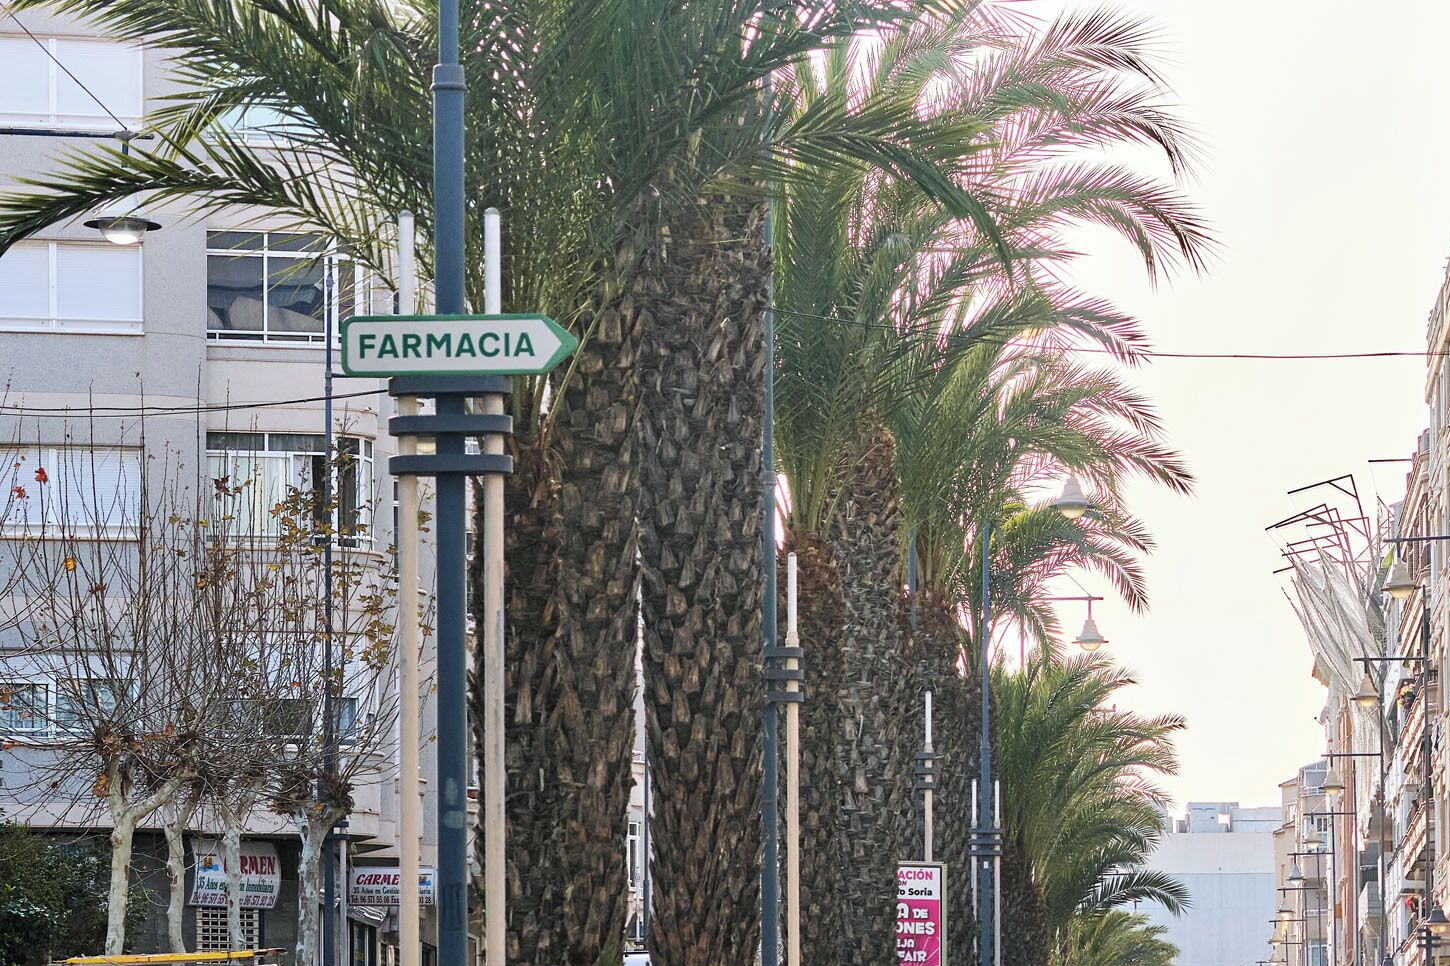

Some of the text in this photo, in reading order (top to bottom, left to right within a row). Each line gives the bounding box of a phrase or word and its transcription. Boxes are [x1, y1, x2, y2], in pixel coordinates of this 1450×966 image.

[359, 332, 535, 359] FARMACIA
[224, 856, 276, 875] RMEN
[356, 873, 400, 885] CARME
[897, 868, 933, 881] ACIÓN
[908, 887, 933, 896] Soria
[896, 902, 929, 919] A DE
[896, 921, 935, 935] ONES
